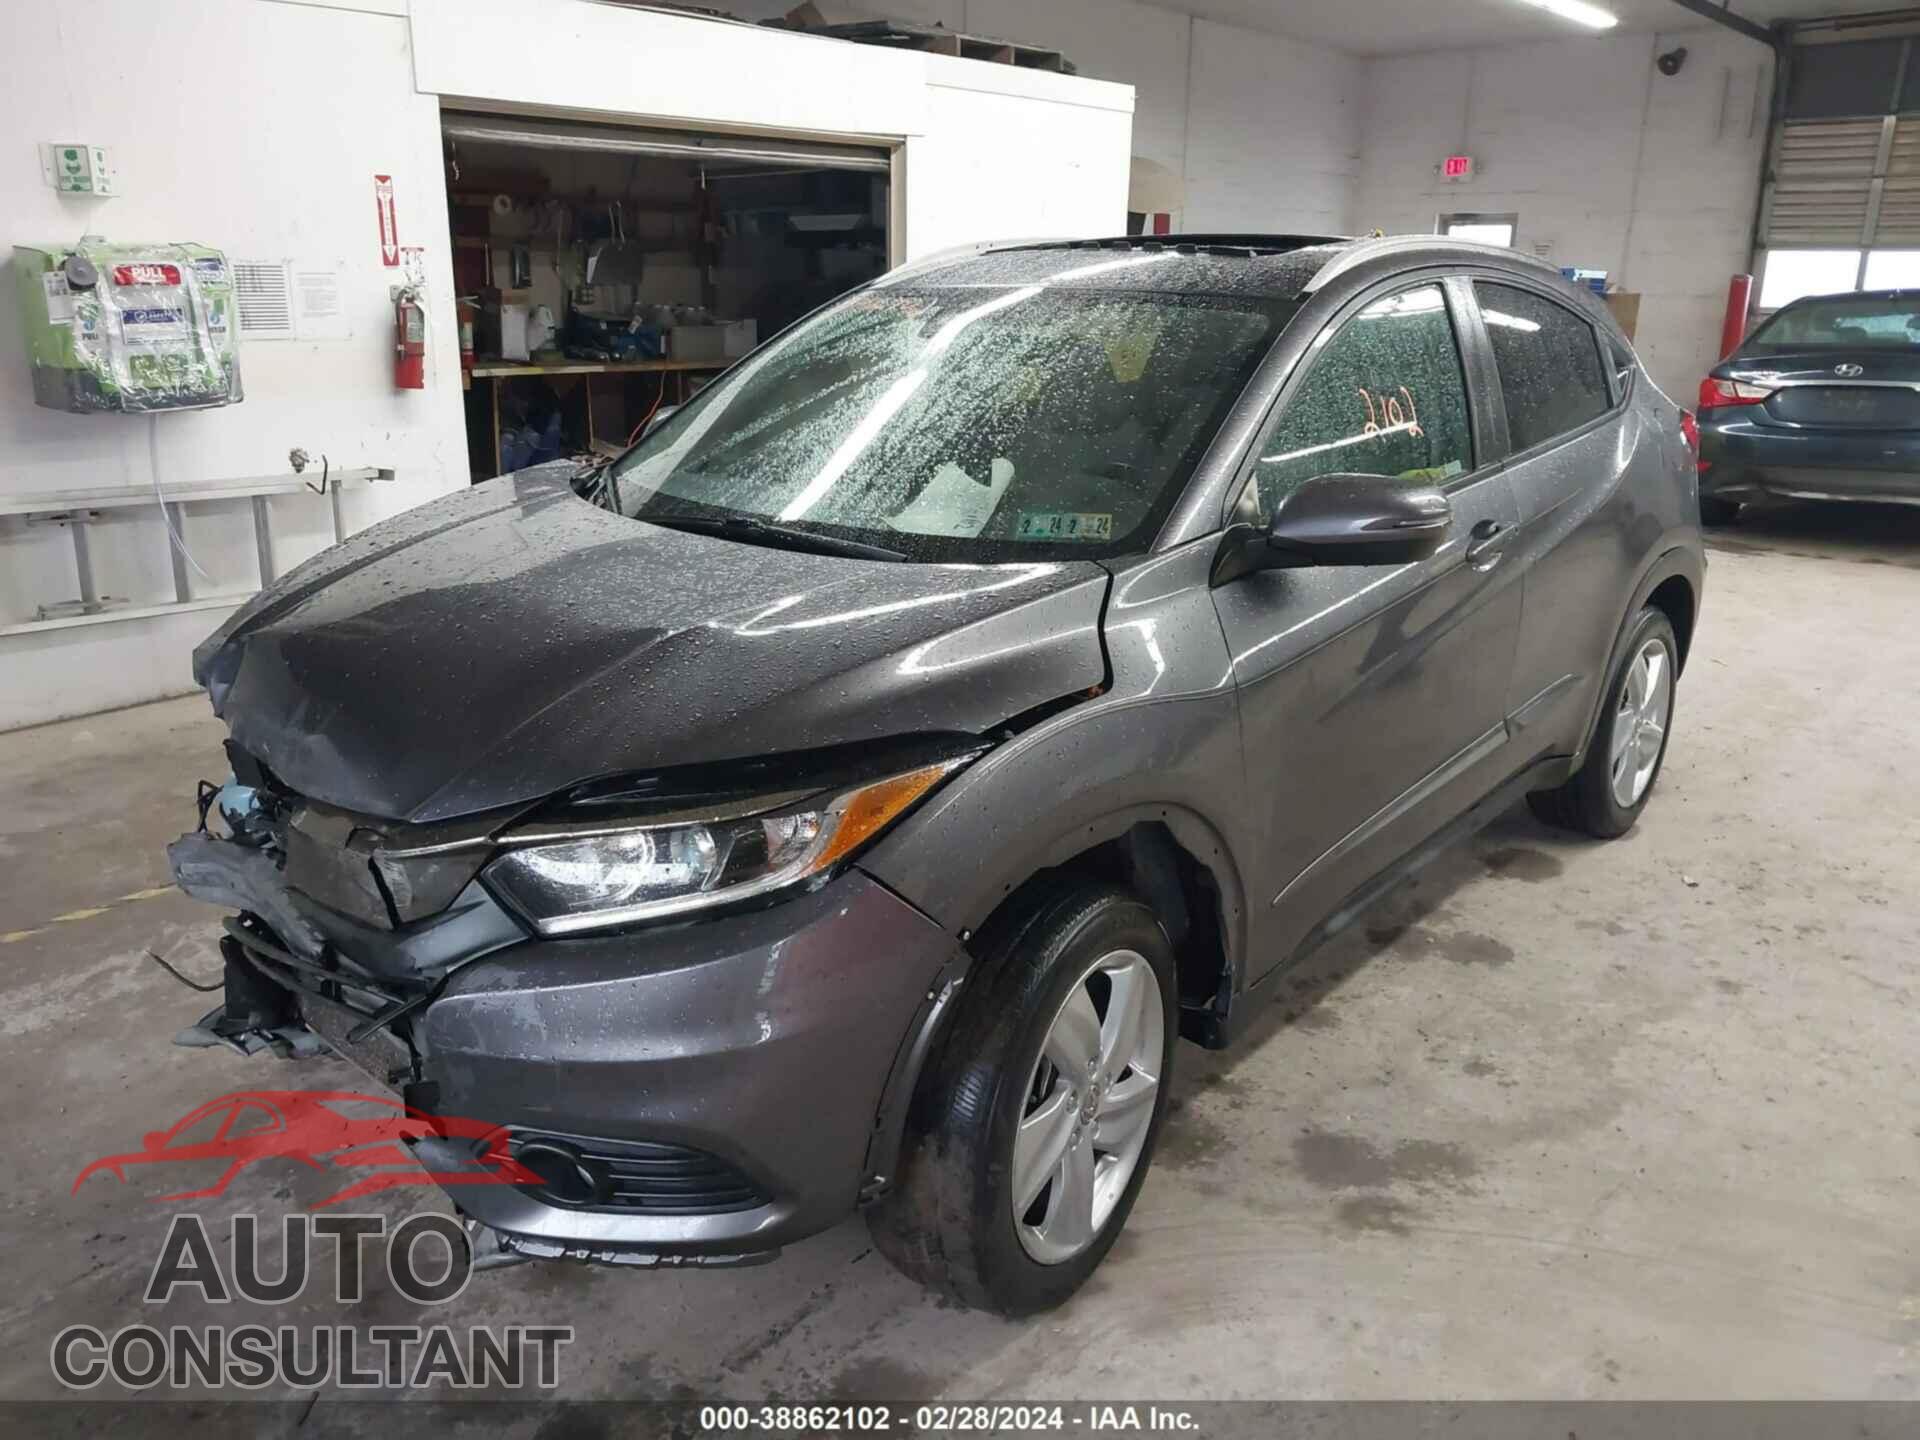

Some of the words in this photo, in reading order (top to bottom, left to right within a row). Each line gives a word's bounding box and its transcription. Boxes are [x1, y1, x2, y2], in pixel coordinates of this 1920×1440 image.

[133, 266, 166, 283] PULL
[1360, 386, 1424, 437] 2102
[1023, 519, 1032, 534] 2
[1049, 517, 1062, 534] 24
[1069, 519, 1077, 534] 2
[1096, 517, 1109, 534] 24
